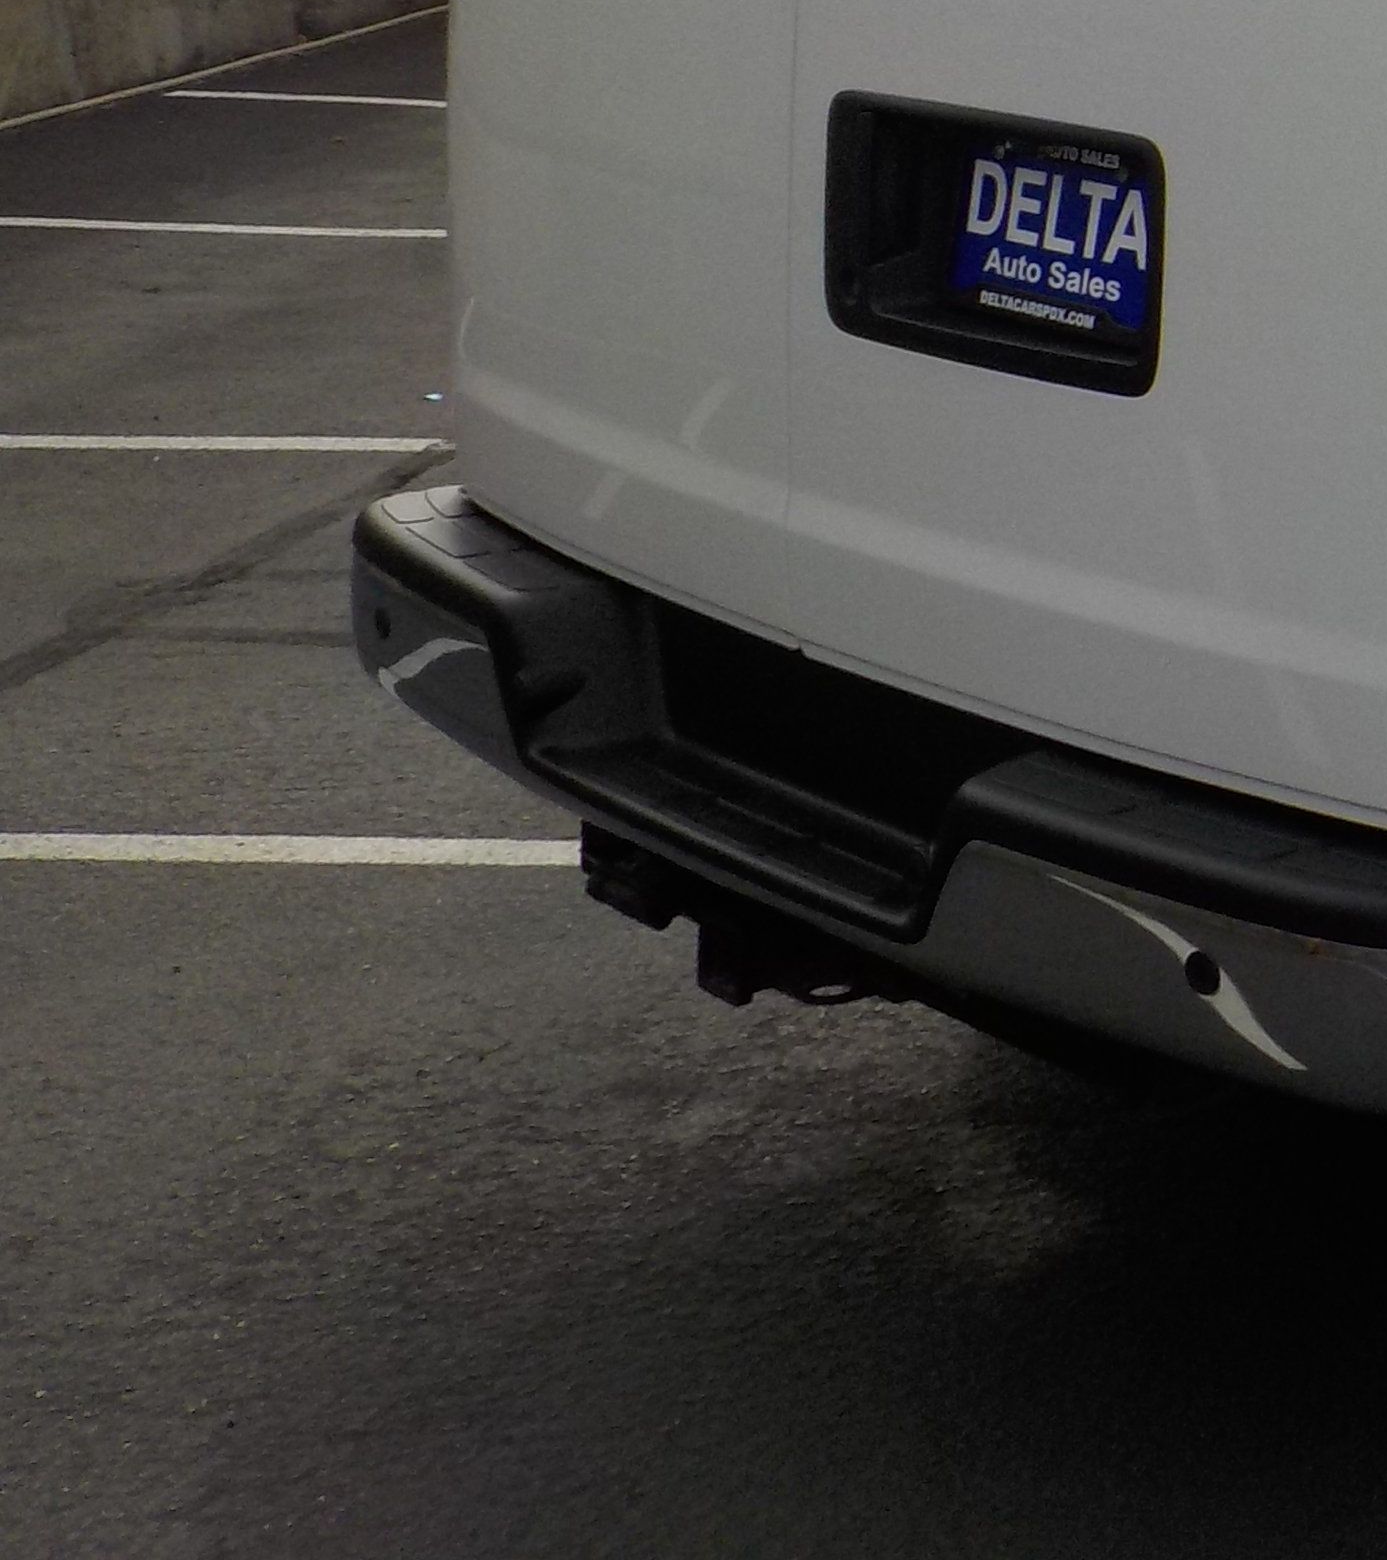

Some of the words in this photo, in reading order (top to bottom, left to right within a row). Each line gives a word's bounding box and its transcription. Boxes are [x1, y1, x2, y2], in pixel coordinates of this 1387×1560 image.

[966, 158, 1148, 272] DELTA
[982, 247, 1042, 284] Auto
[1047, 260, 1122, 303] Sales
